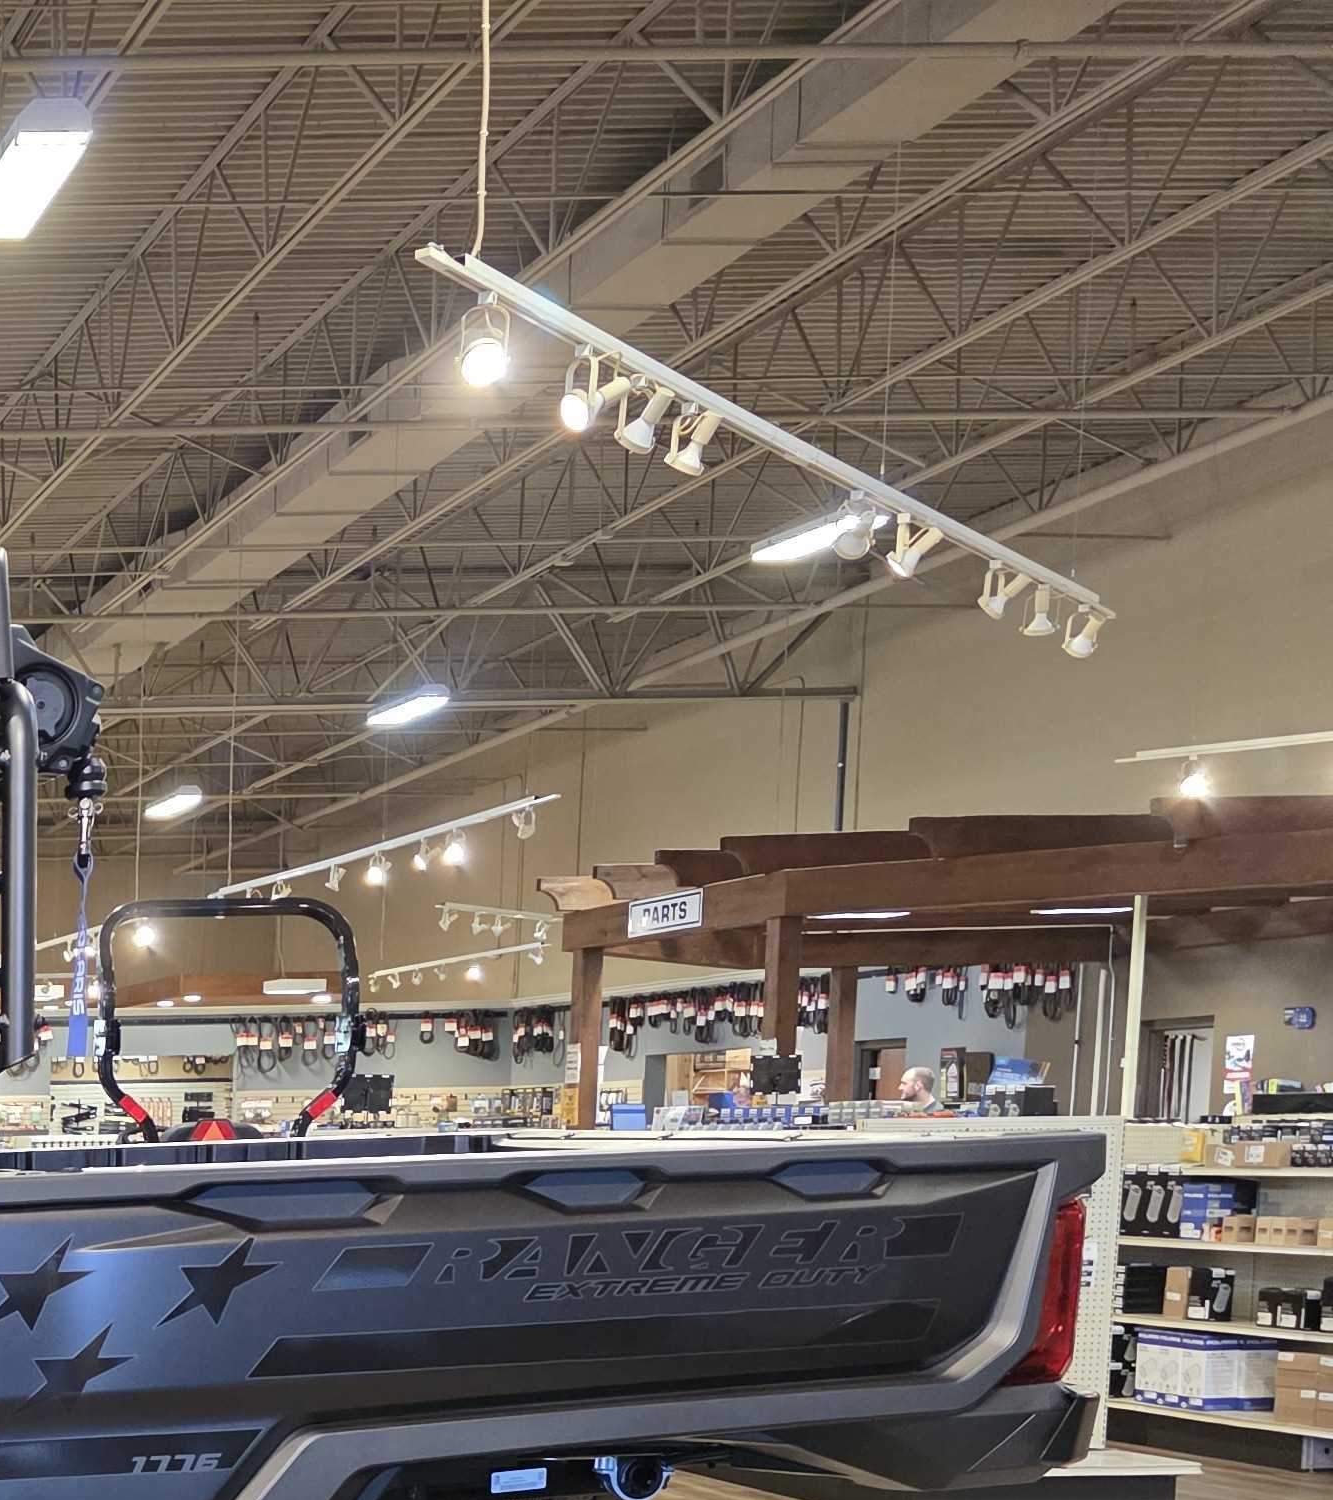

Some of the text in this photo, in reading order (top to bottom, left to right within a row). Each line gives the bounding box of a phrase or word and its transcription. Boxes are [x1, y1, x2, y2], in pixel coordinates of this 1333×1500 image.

[425, 1213, 893, 1288] RANGER
[523, 1263, 889, 1302] EXTREME DUTY
[131, 1453, 222, 1474] 1776
